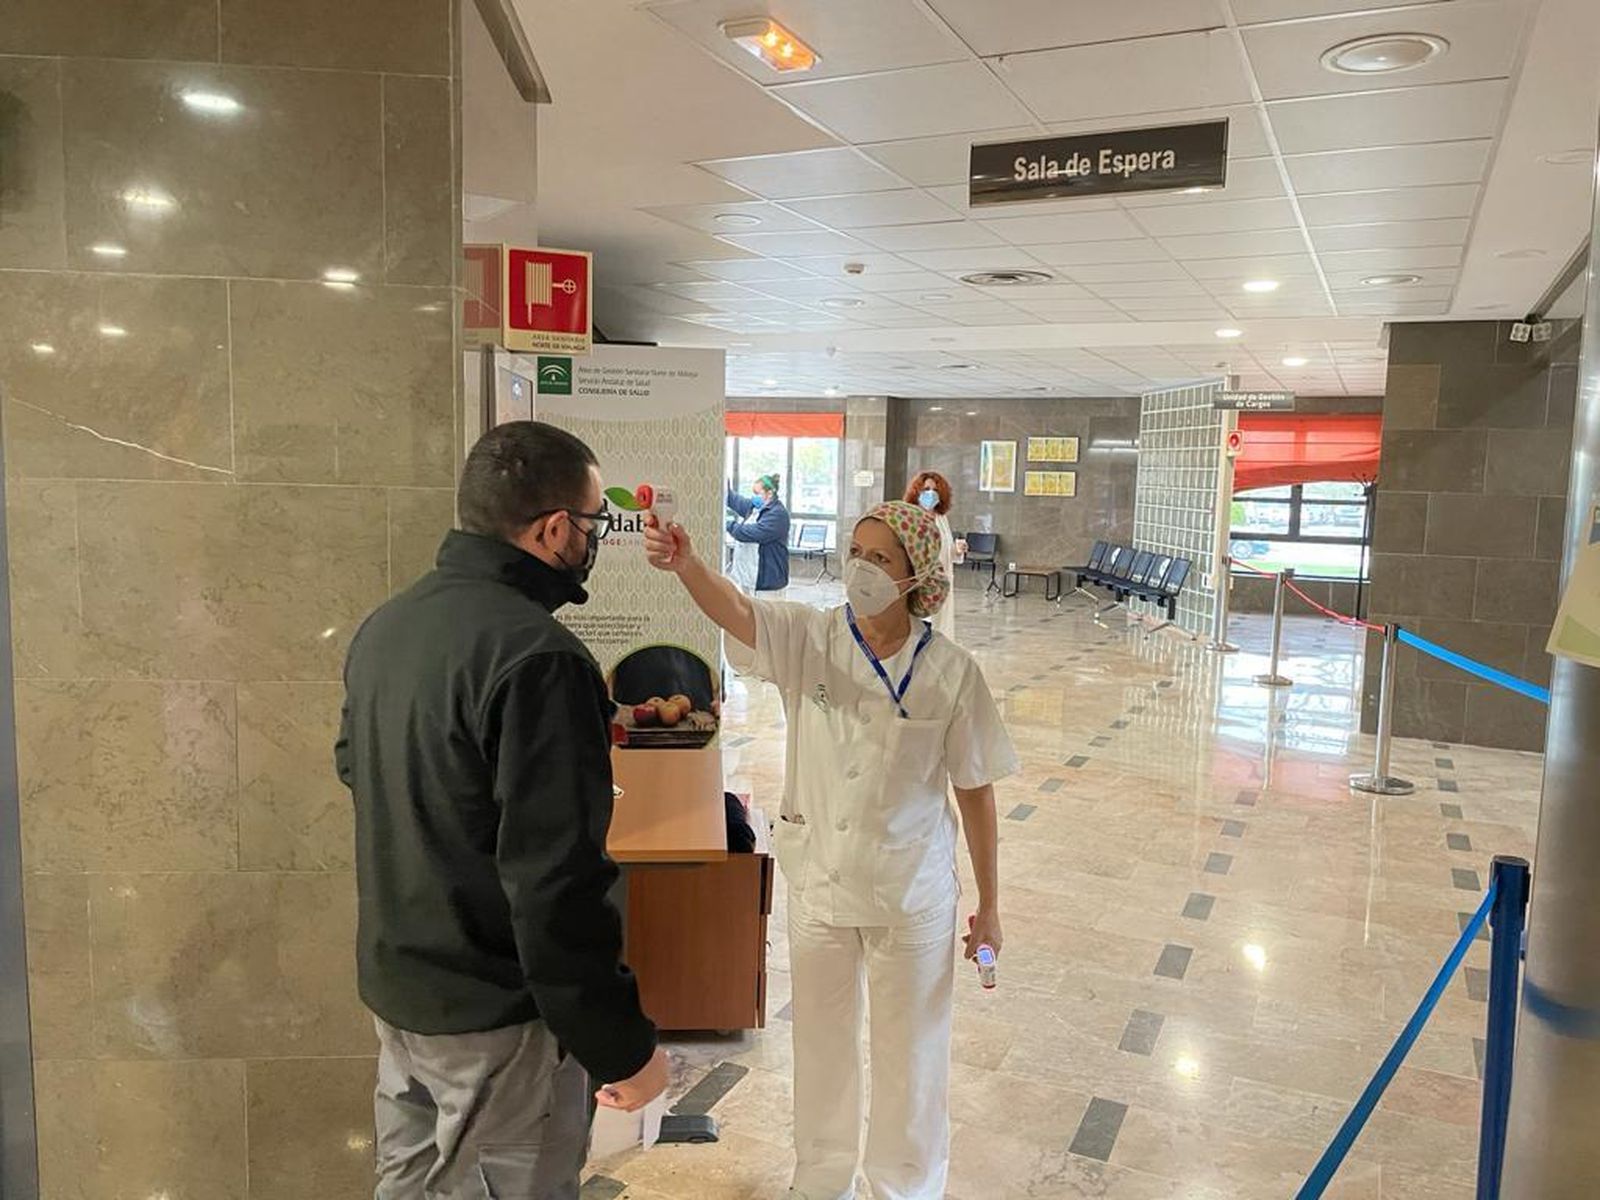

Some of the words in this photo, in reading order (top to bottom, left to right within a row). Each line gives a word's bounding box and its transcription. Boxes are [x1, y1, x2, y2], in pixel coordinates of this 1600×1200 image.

[1013, 155, 1058, 181] Sala
[1065, 152, 1091, 176] de
[1099, 149, 1176, 178] Espera
[635, 378, 651, 386] Salud
[618, 388, 627, 396] DE
[629, 388, 650, 396] SALUD
